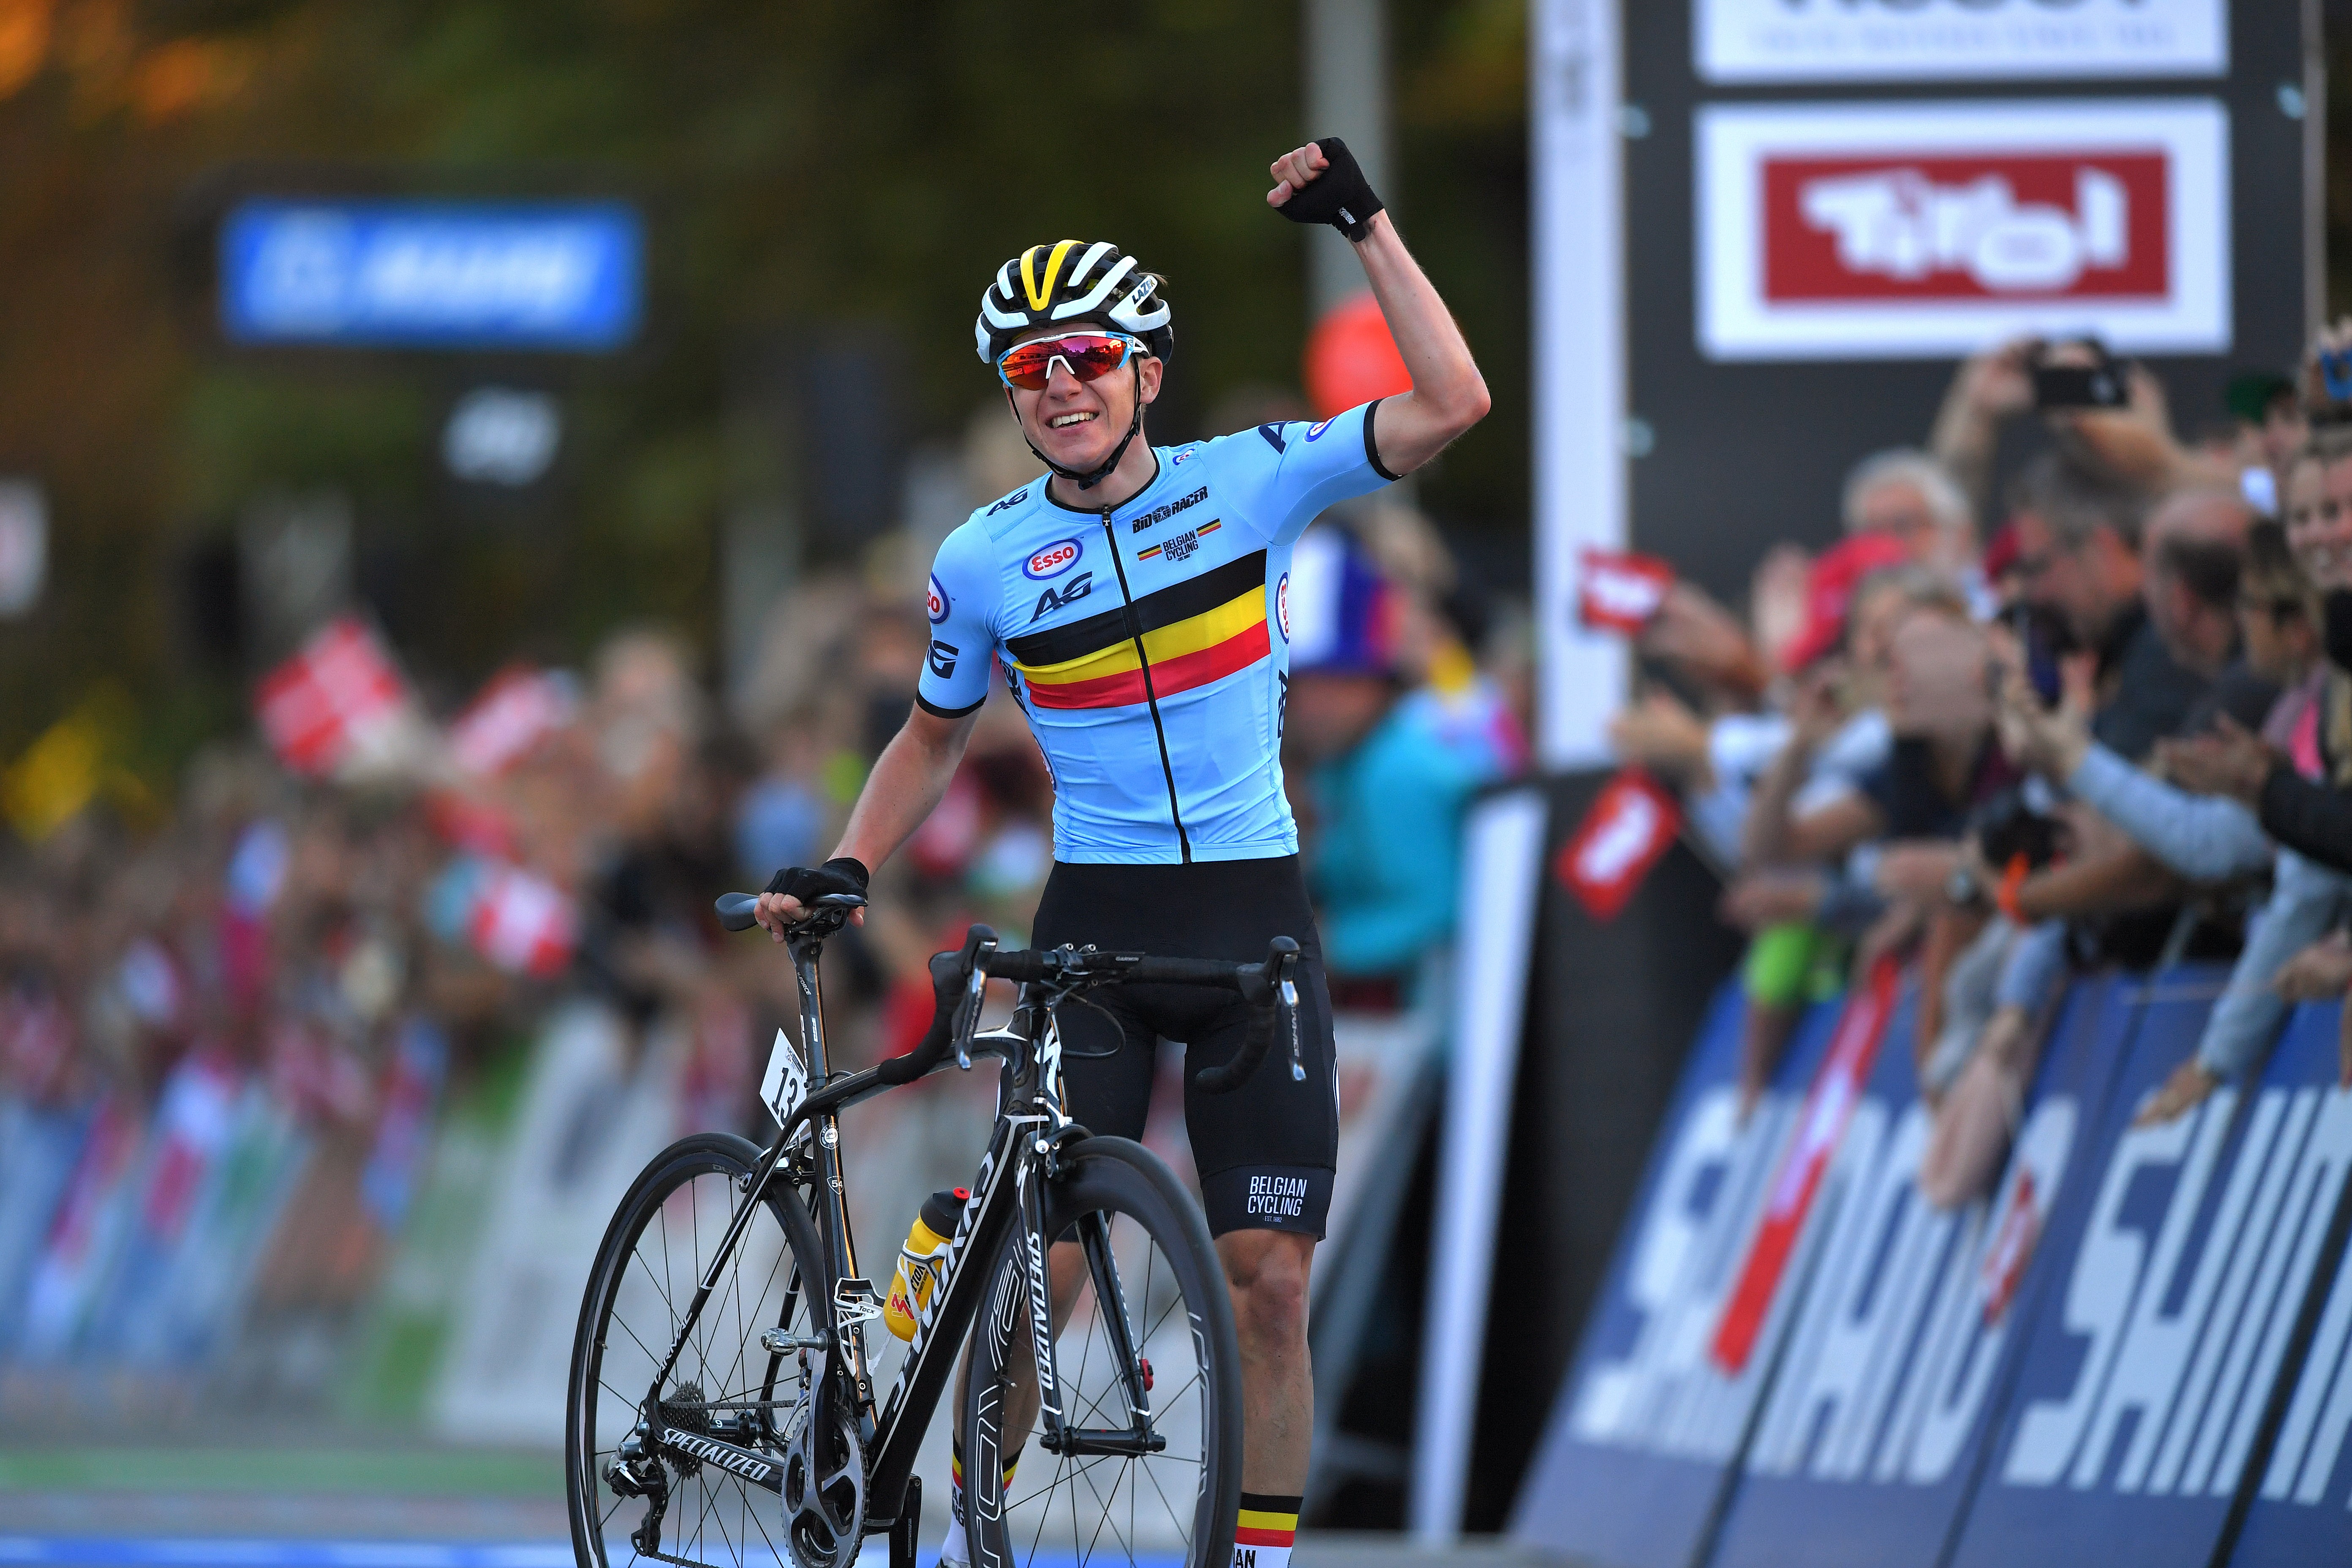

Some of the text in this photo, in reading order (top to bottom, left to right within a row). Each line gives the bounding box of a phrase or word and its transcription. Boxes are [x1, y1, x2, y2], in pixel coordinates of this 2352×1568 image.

[1162, 530, 1196, 552] BELGIAN
[1166, 540, 1199, 561] CYCLING
[831, 1180, 843, 1188] 54
[1250, 1176, 1307, 1198] BELGIAN
[1247, 1196, 1303, 1216] CYCLING
[859, 1306, 875, 1314] Tacx
[1026, 1232, 1054, 1391] SPECIALIZED
[715, 1420, 723, 1428] 9
[663, 1428, 771, 1481] SPECIALIZED
